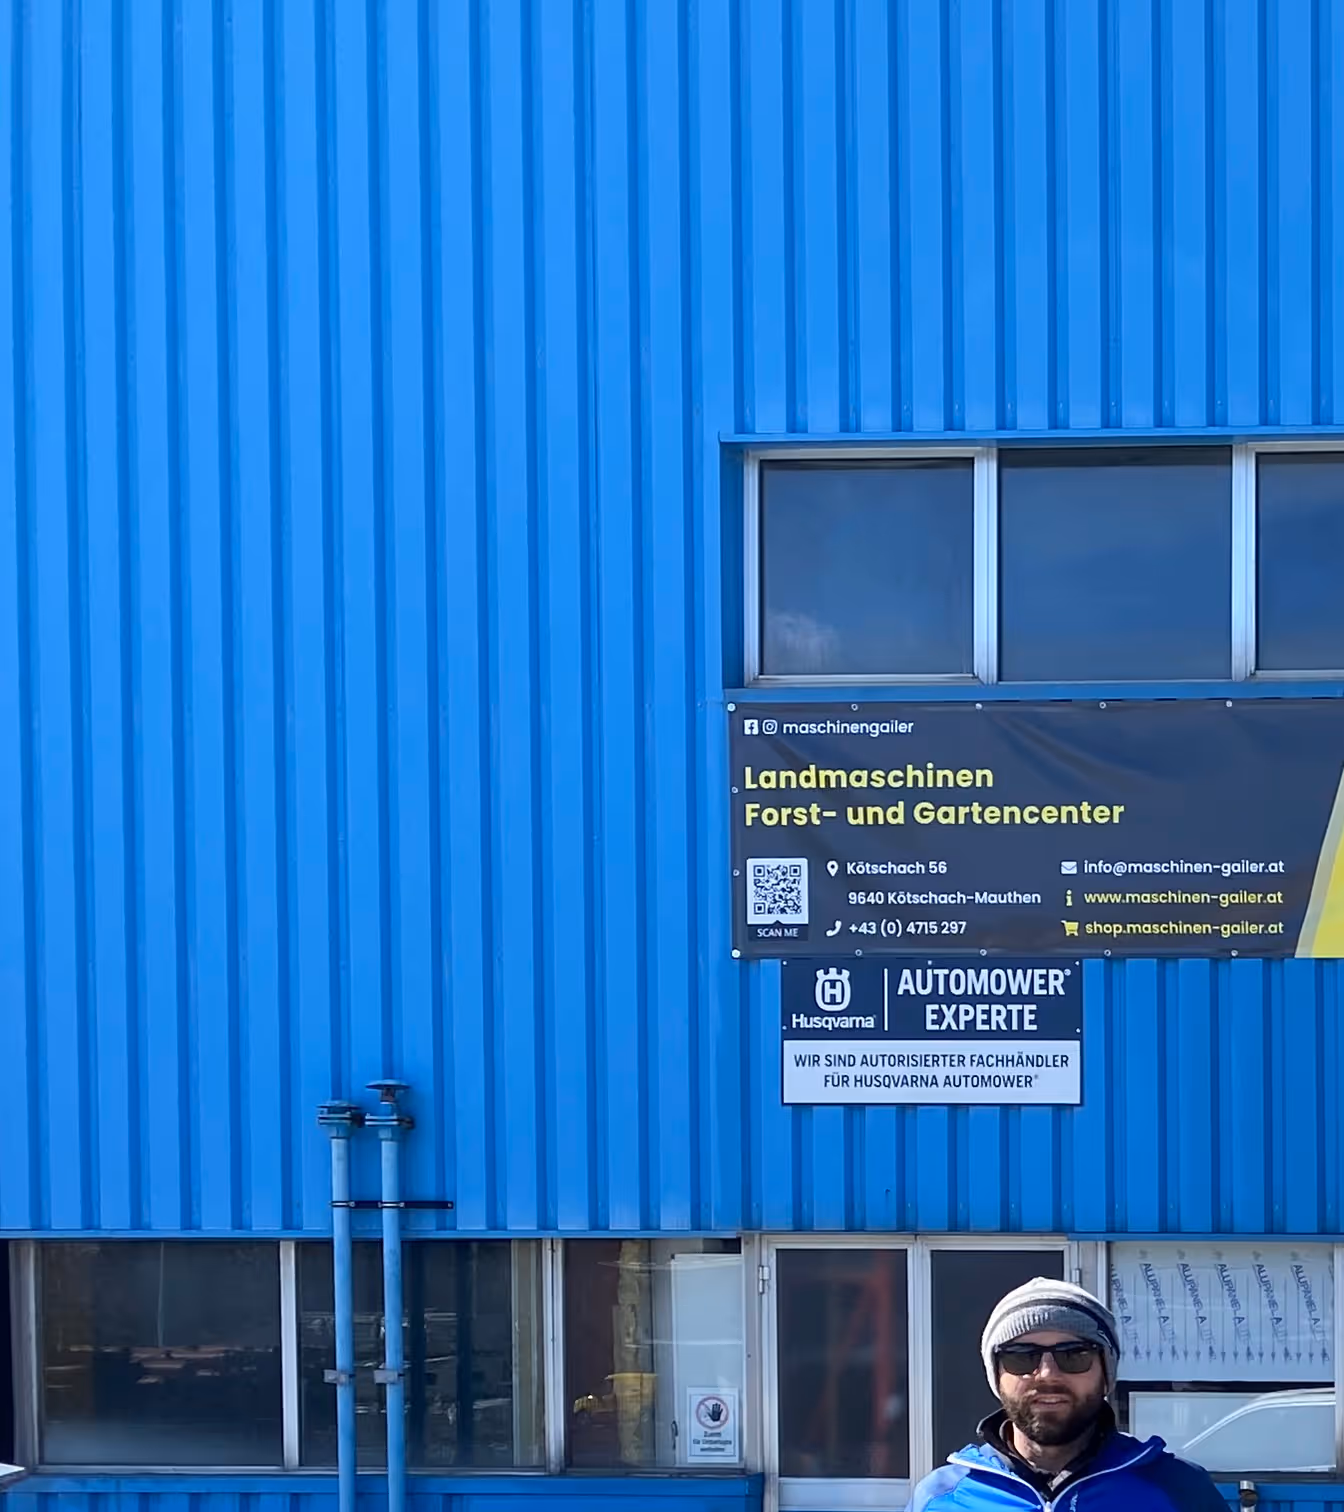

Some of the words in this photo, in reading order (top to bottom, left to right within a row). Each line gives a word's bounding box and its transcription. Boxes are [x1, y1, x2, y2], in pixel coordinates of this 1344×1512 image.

[783, 720, 914, 737] maschinengailer
[744, 763, 994, 790] Landmaschinen
[744, 803, 837, 827] Forst-
[847, 801, 905, 826] und
[913, 801, 1126, 826] Gartencenter
[846, 861, 926, 875] Kötschach
[928, 861, 948, 875] 56
[1084, 859, 1285, 877] info@maschinen-gailer.at
[848, 892, 884, 905] 9640
[887, 891, 1042, 905] Kötschach-Mauthen
[1084, 890, 1283, 907] www.maschinen-gailer.at
[757, 928, 781, 938] SCAN
[782, 928, 799, 938] ME
[849, 922, 877, 935] +43
[881, 919, 903, 938] (0)
[906, 921, 938, 935] 4715
[941, 921, 967, 935] 297
[1084, 921, 1284, 938] shop.maschinen-gailer.at
[925, 1004, 1038, 1031] EXPERTE
[794, 1054, 820, 1068] WIR
[824, 1054, 856, 1068] SIND
[860, 1054, 966, 1068] AUTORISIERTER
[970, 1051, 1069, 1068] FACHHÄNDLER
[824, 1073, 850, 1089] FÜR
[853, 1074, 939, 1089] HUSQVARNA
